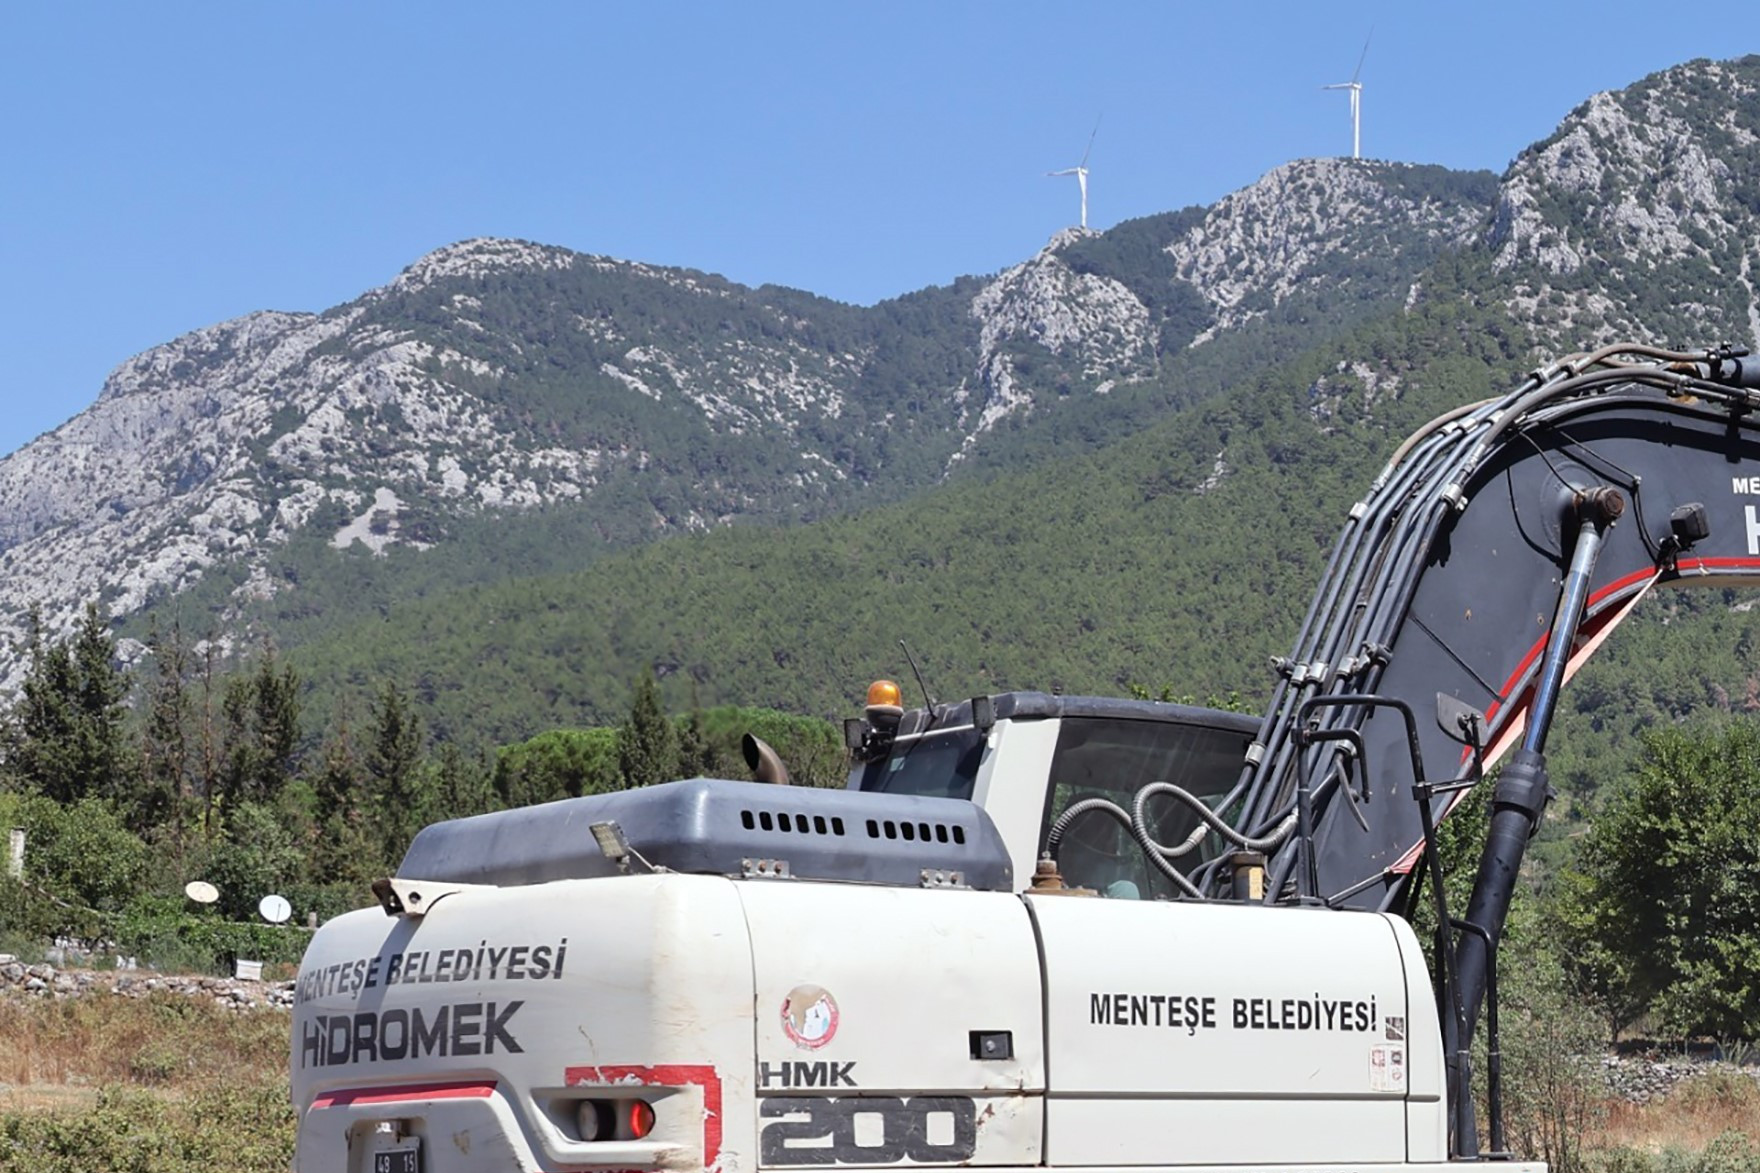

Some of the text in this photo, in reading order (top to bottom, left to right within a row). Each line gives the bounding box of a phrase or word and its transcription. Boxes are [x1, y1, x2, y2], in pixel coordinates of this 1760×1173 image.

[385, 938, 567, 986] BELEDİYESİ
[1090, 993, 1216, 1036] MENTEŞE
[1233, 992, 1377, 1031] BELEDİYESİ
[761, 1061, 857, 1087] HMK
[760, 1096, 976, 1165] 200
